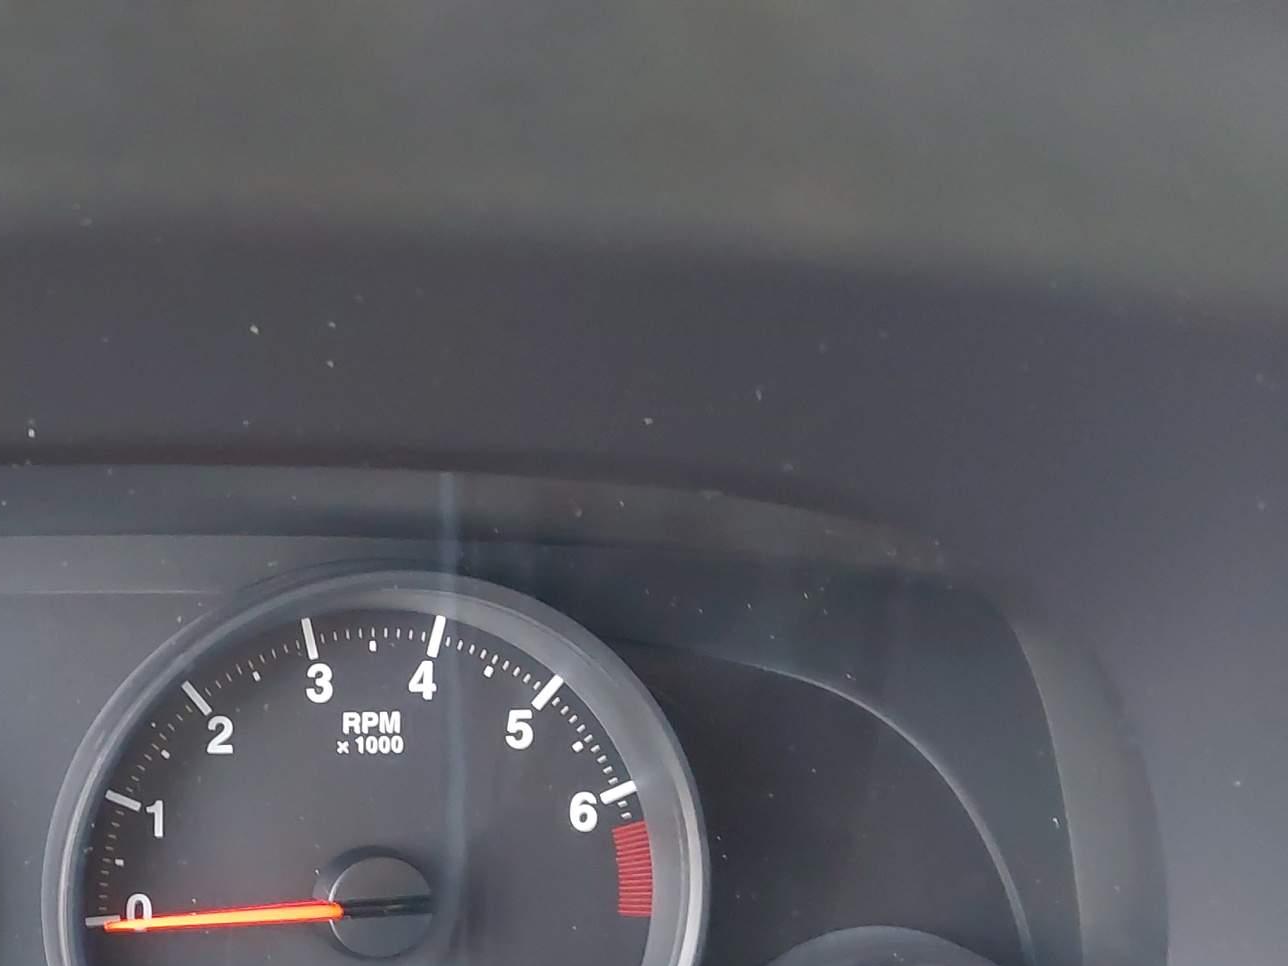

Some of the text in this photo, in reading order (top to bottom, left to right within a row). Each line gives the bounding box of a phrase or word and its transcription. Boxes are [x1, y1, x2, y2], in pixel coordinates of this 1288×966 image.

[306, 664, 334, 703] 3
[409, 662, 437, 699] 4
[207, 715, 234, 754] 2
[342, 712, 401, 735] RPM
[506, 710, 534, 749] 5
[354, 736, 404, 754] 1000
[145, 800, 164, 837] 1
[569, 793, 597, 832] 6
[126, 894, 152, 931] 0
